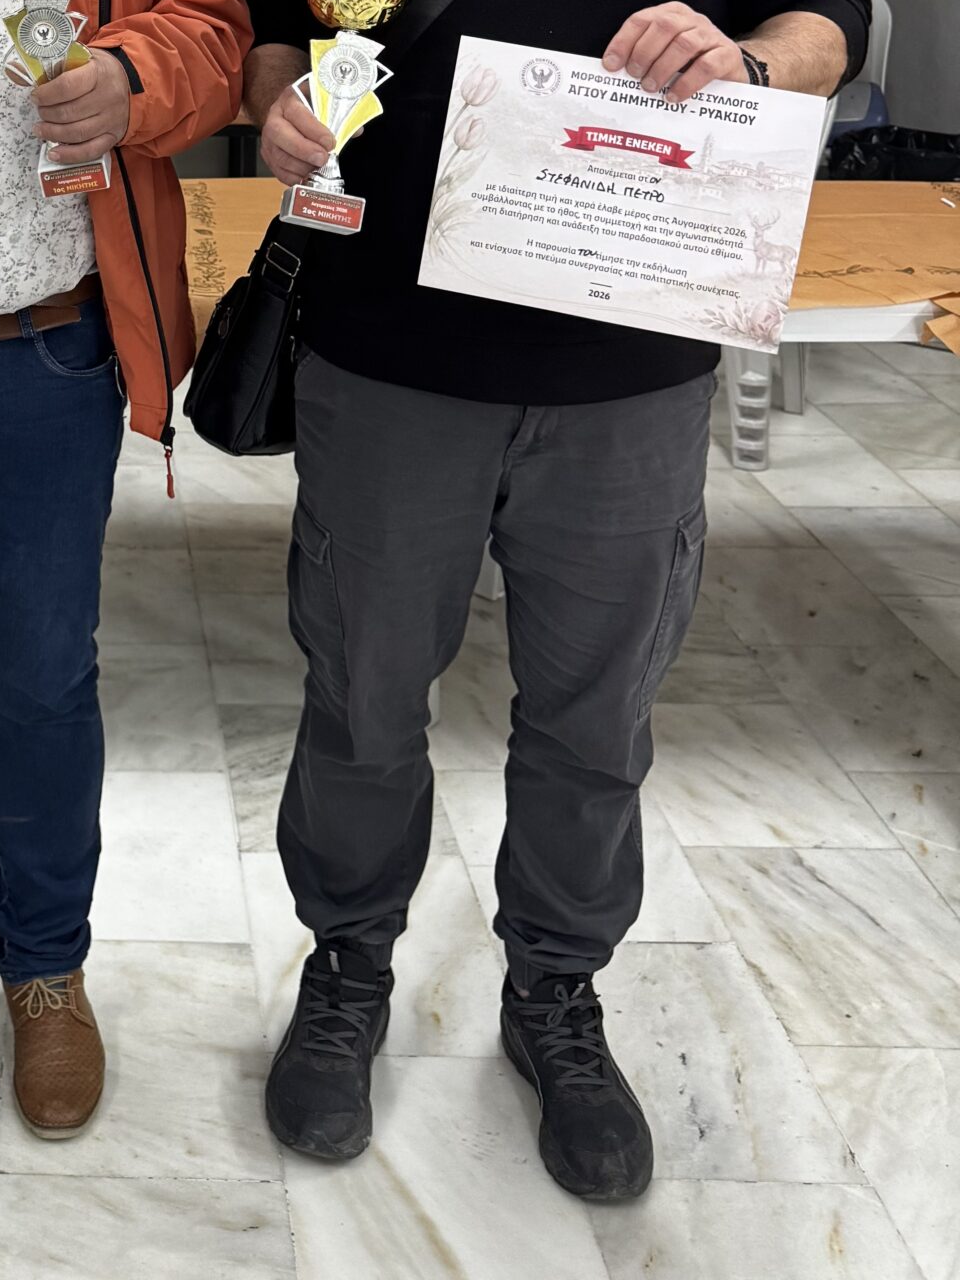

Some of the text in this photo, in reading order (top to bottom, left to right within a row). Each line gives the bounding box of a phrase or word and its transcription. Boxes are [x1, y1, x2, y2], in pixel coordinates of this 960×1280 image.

[568, 84, 608, 101] ΑΓΙΟΥ
[609, 91, 688, 114] ΔΗΜΗΤΡΙΟΥ
[698, 107, 757, 126] ΡΥΑΚΙΟΥ
[570, 70, 642, 90] ΜΟΡΦΩΤΙΚΟΣ
[705, 94, 760, 111] ΣΥΛΛΟΓΟΣ
[586, 131, 672, 156] ΤΙΜΗΣ ΕΝΕΚΕΝ
[587, 164, 636, 180] Απονέμεται
[471, 192, 532, 210] συμβάλλοντας
[533, 204, 545, 212] με
[582, 213, 592, 222] τη
[593, 215, 642, 231] συμμετοχή
[643, 224, 657, 232] και
[659, 227, 674, 236] την
[486, 183, 748, 239] με ιδιαίτερη τιμή και χαρά έλαβε μέρος στις Αυγομαχίες 2026,
[482, 205, 743, 261] στη διατήρηση και ανάδειξη του παραδοσιακού αυτού εθίμου.
[470, 240, 483, 248] και
[485, 243, 523, 257] ενίσχυσε
[524, 250, 534, 258] το
[535, 252, 567, 265] πνεύμα
[568, 259, 623, 277] συνεργασίας
[624, 271, 638, 279] και
[640, 272, 694, 291] πολιτιστικής
[526, 238, 534, 246] Η
[535, 241, 577, 255] παρουσία
[626, 259, 640, 269] την
[642, 261, 688, 279] εκδήλωση
[588, 289, 611, 300] 2026
